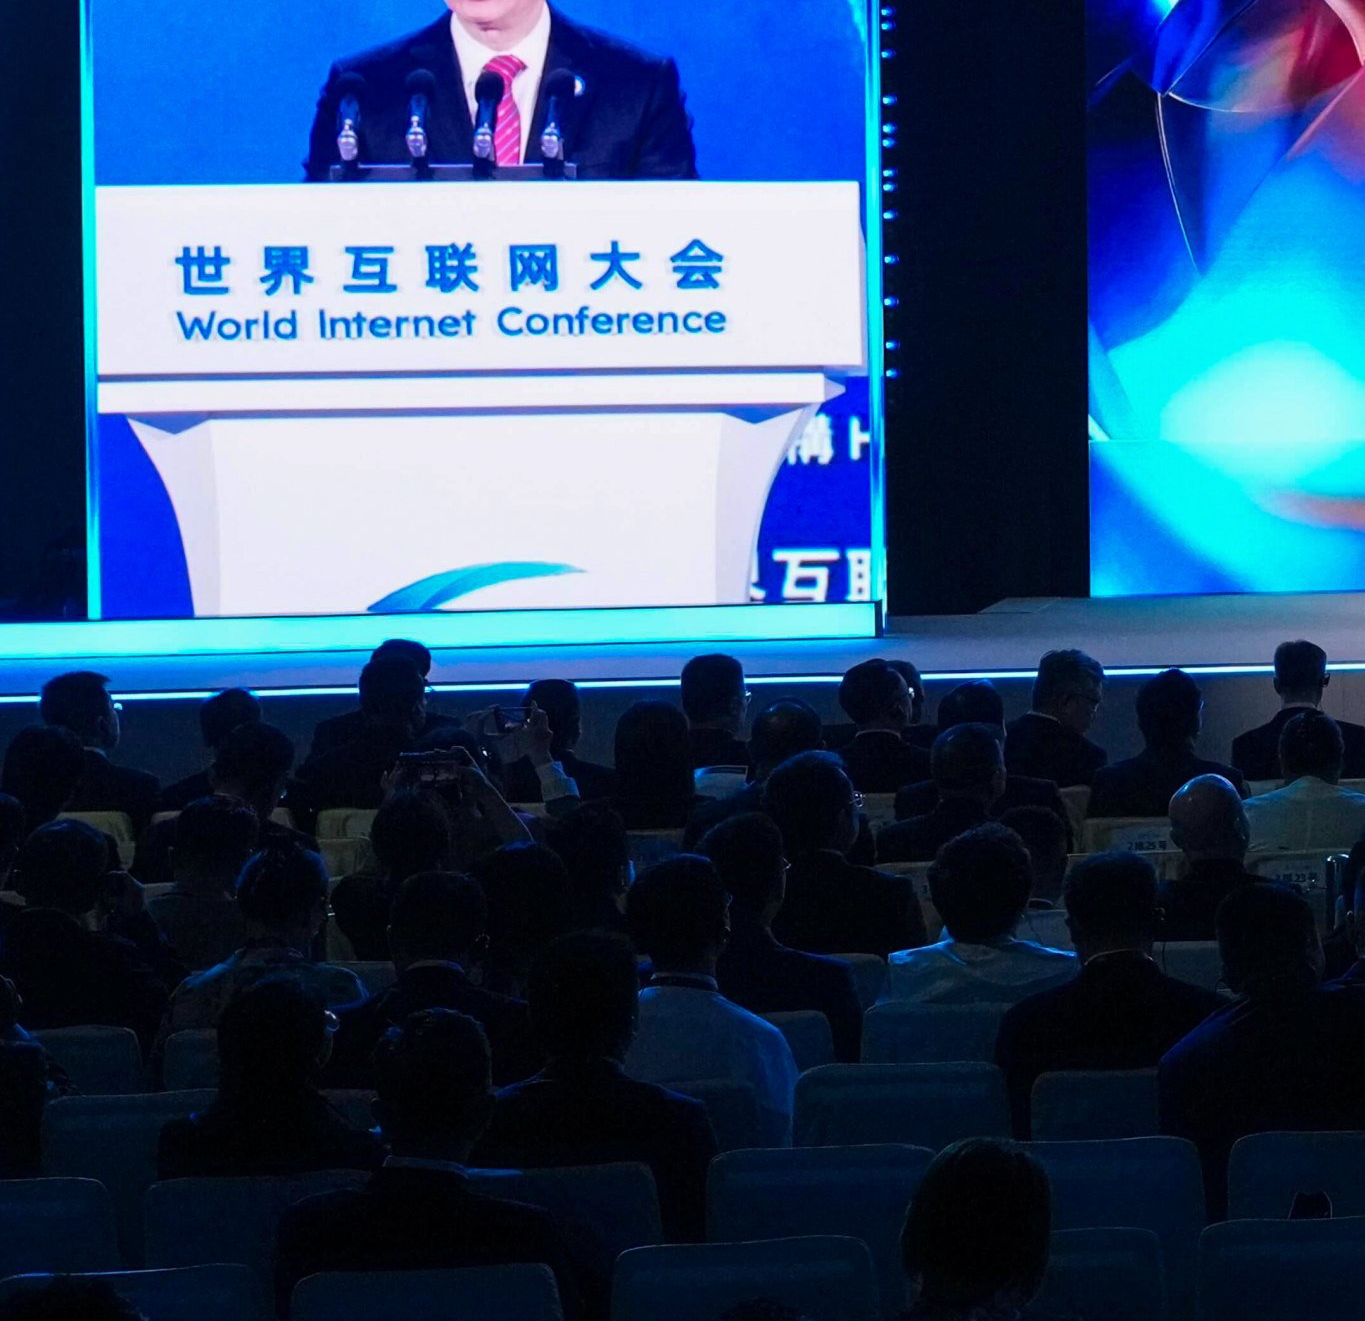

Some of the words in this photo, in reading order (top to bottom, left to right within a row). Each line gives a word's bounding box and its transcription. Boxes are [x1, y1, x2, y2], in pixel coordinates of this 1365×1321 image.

[175, 239, 723, 296] 世界互联网大会
[177, 311, 297, 340] World
[320, 310, 476, 339] Internet
[497, 306, 726, 336] Conference
